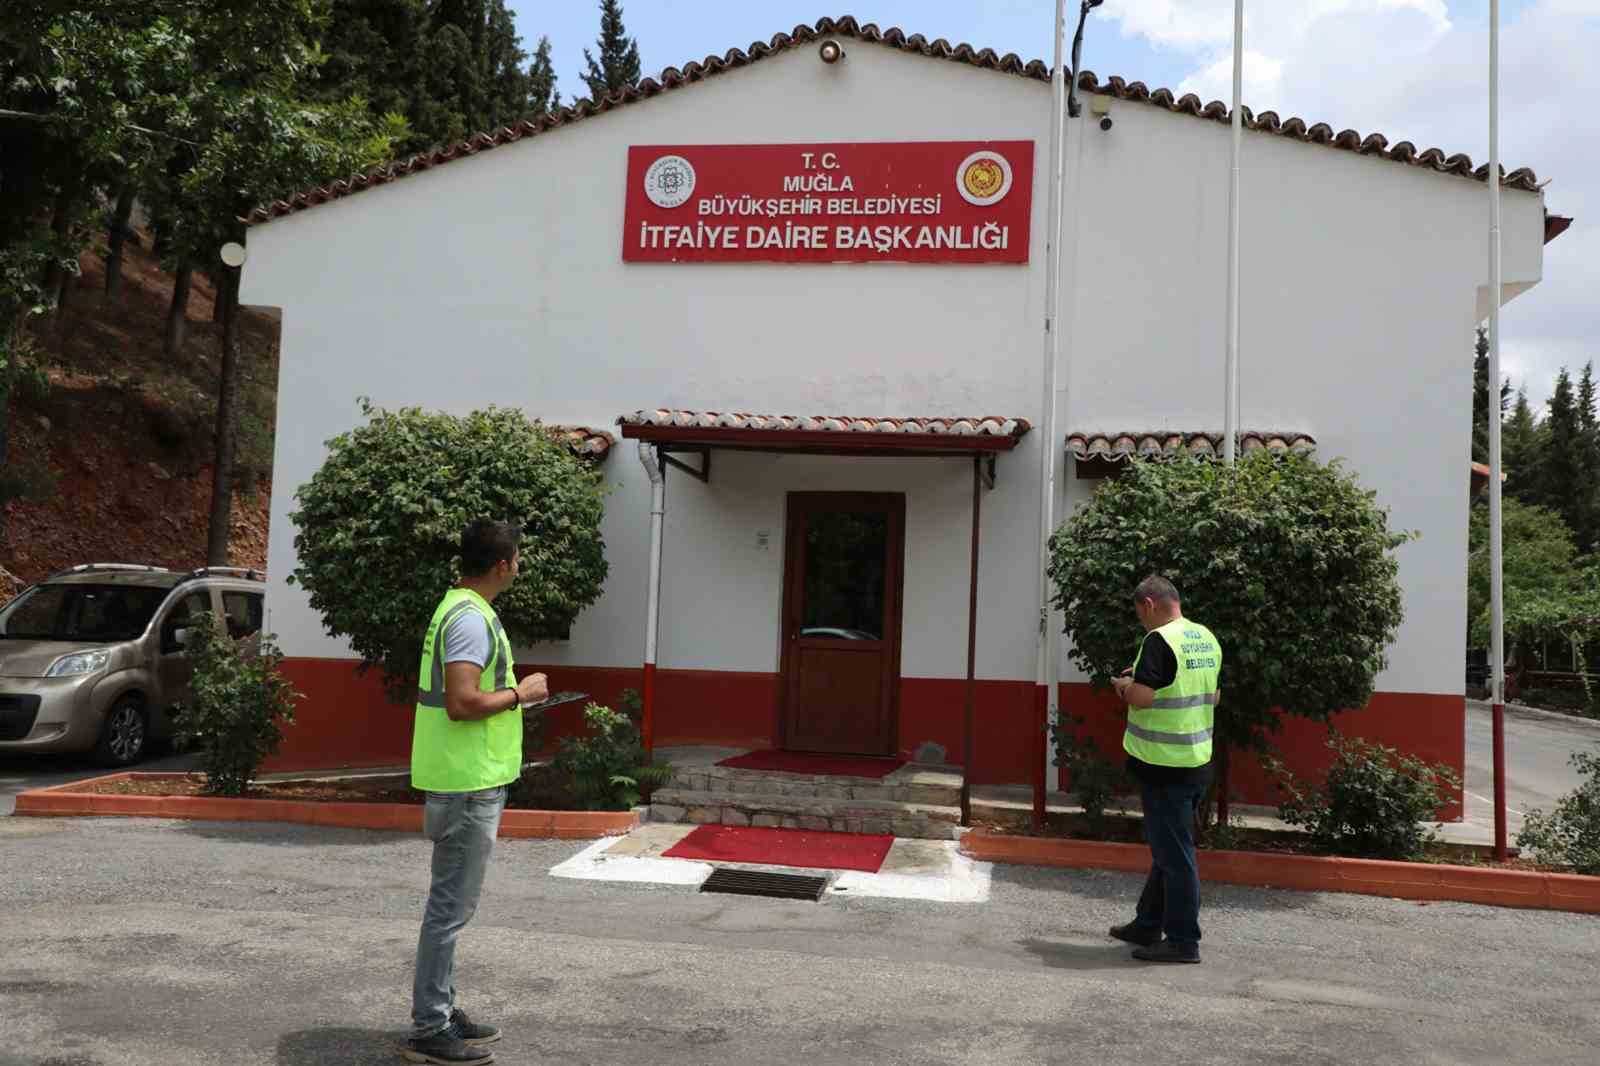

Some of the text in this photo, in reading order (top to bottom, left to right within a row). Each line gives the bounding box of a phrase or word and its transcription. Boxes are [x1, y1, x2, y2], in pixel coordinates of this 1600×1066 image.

[801, 153, 840, 169] T. C.
[784, 173, 854, 192] MUĞLA
[698, 194, 941, 218] BÜYÜKŞEHİR BELEDİYESİ
[640, 221, 1009, 253] İTFAİYE DAİRE BAŞKANLIĞI
